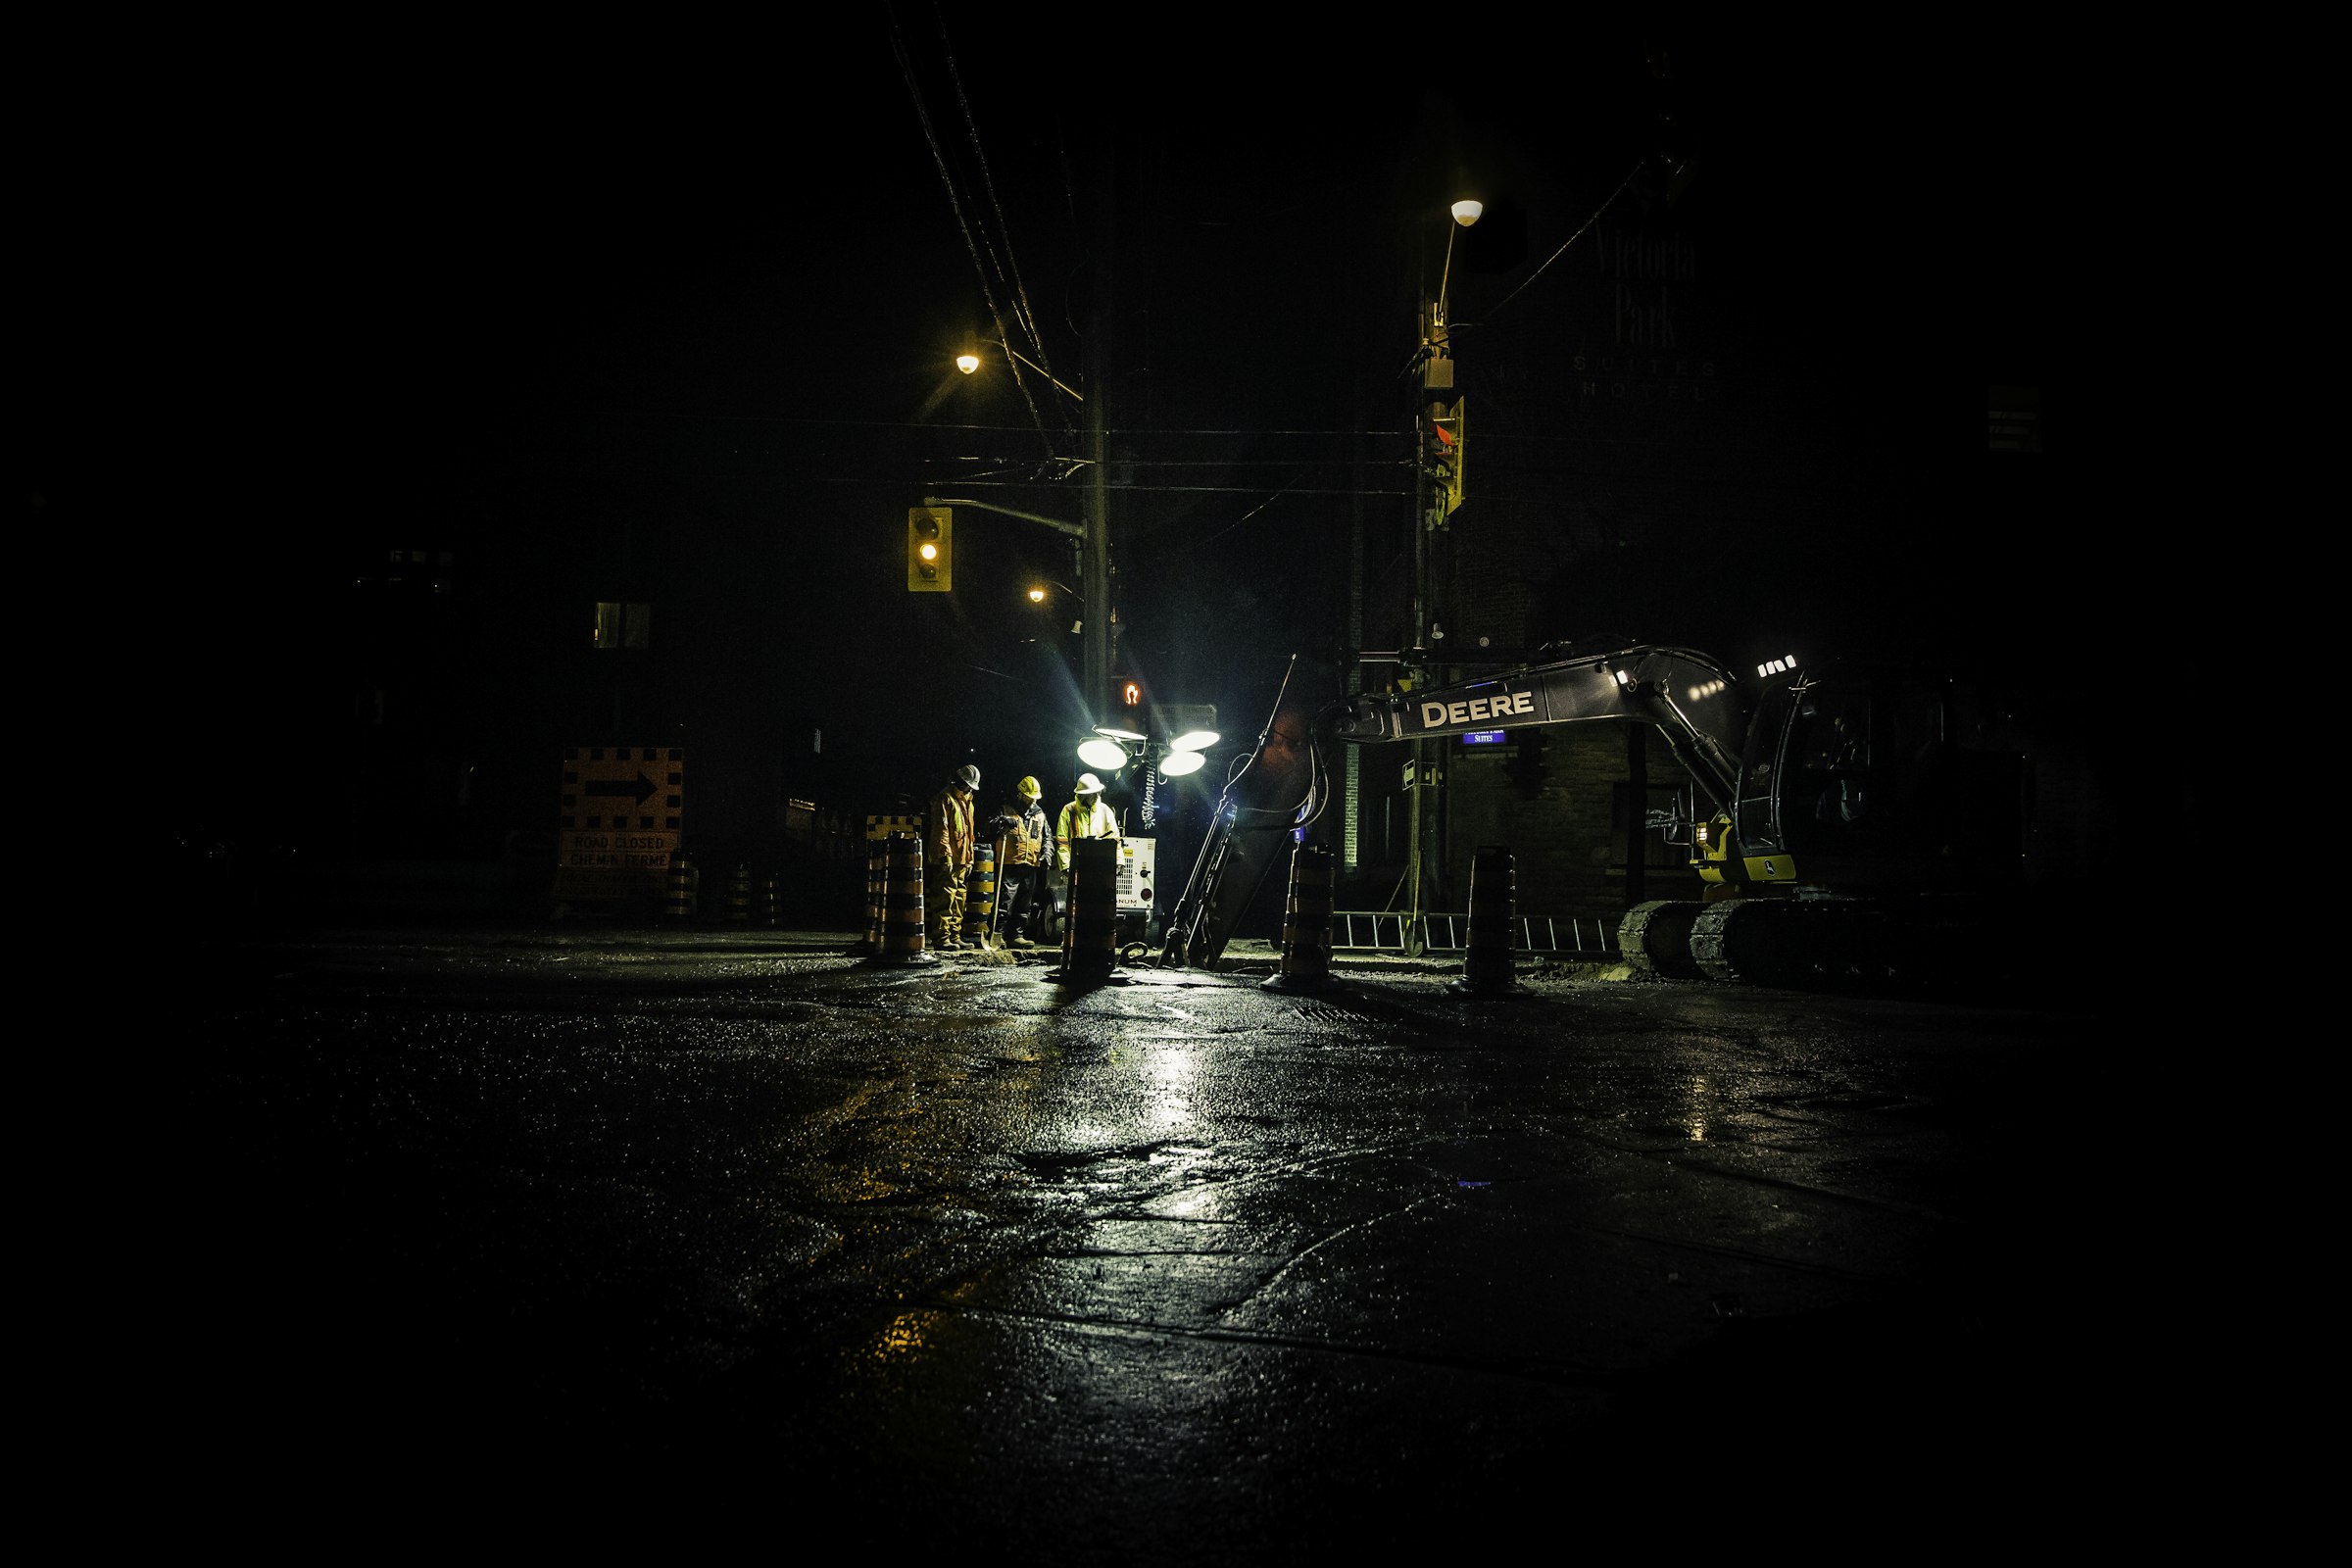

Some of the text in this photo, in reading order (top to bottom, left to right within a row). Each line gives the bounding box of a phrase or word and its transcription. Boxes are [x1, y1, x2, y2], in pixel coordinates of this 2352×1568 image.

[1615, 282, 1677, 349] Park
[1573, 356, 1715, 377] SUITES
[1421, 691, 1535, 728] DEERE
[574, 837, 663, 849] ROAD CLOSED
[570, 854, 617, 865] CHEMIN
